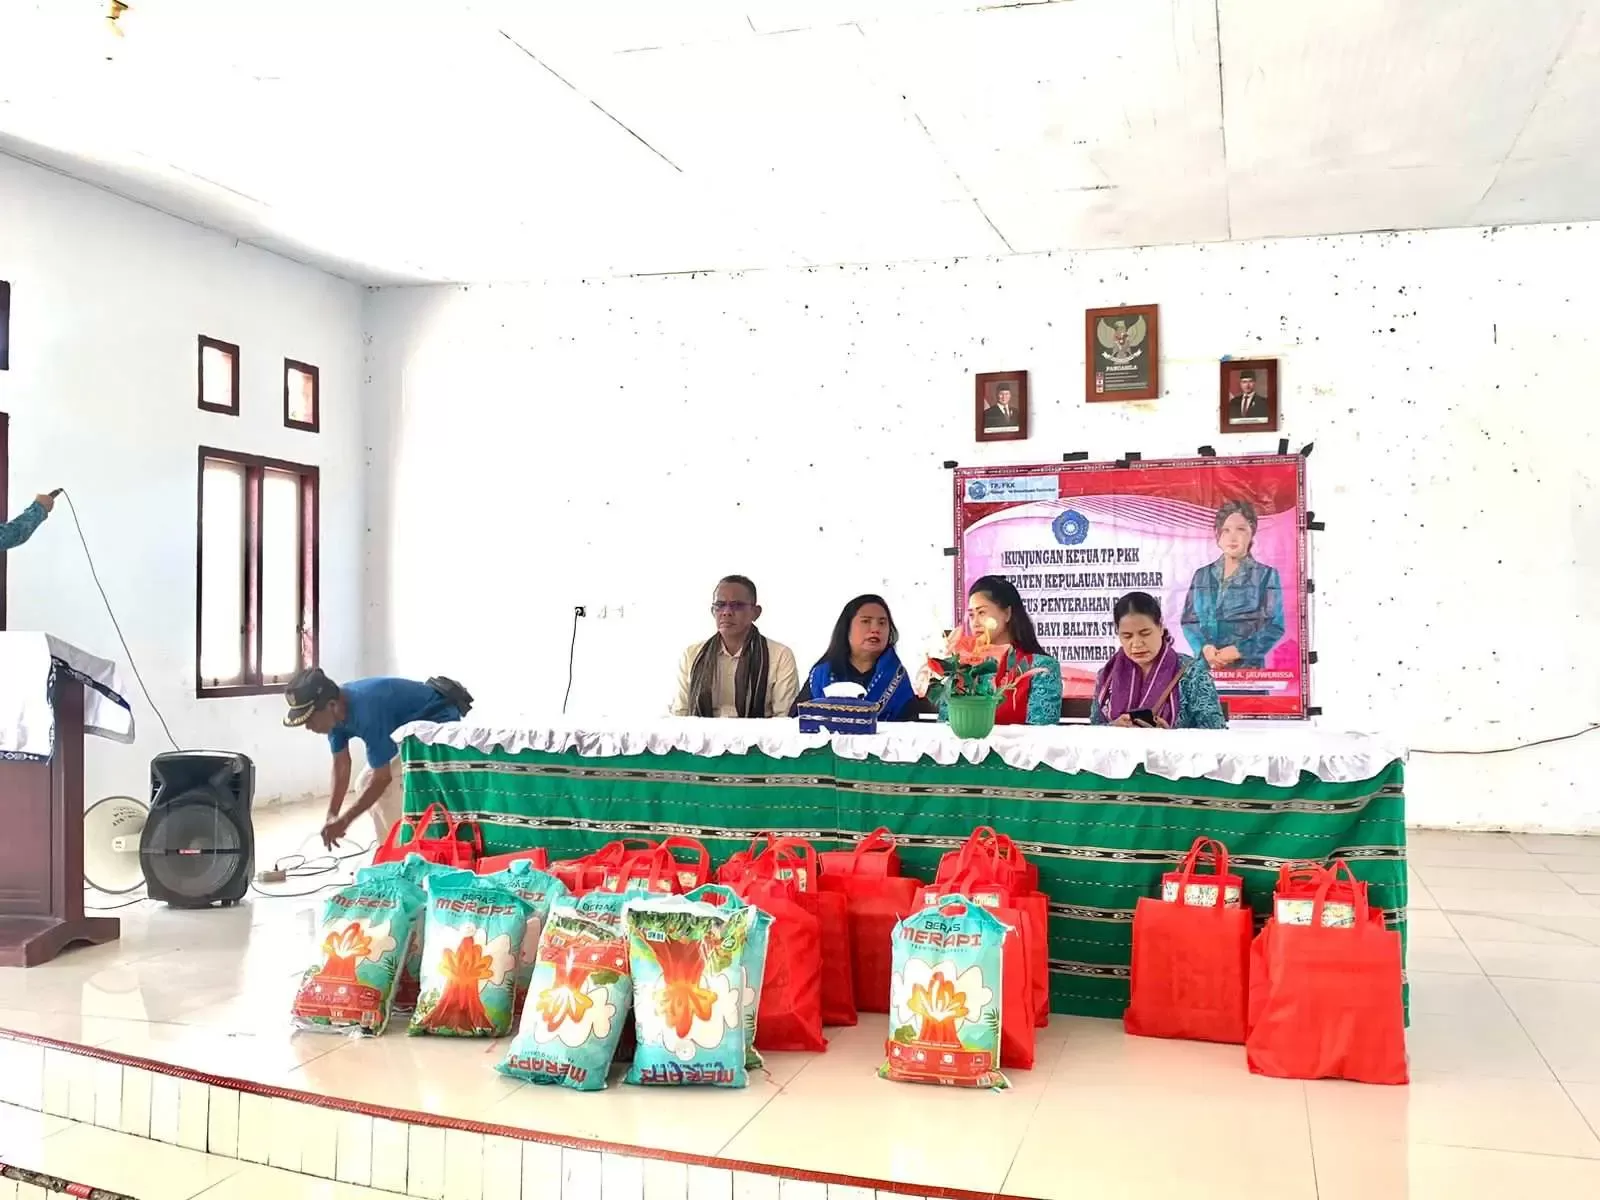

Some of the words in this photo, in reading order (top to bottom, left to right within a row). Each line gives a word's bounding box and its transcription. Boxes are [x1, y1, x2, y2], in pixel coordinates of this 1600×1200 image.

[1004, 549, 1063, 569] KUNJUNGAN
[1065, 549, 1100, 565] KETUA
[1116, 547, 1140, 563] PKK
[1044, 573, 1104, 588] KEPULAUAN
[1106, 571, 1163, 587] TANIMBAR
[1040, 597, 1110, 612] PENYERAHAN
[1037, 622, 1061, 637] BAYI
[1062, 621, 1100, 636] BALITA
[436, 898, 516, 917] MERAPI
[925, 921, 960, 934] BERAS
[900, 927, 982, 948] MERAPI
[508, 1054, 588, 1083] MERAPI
